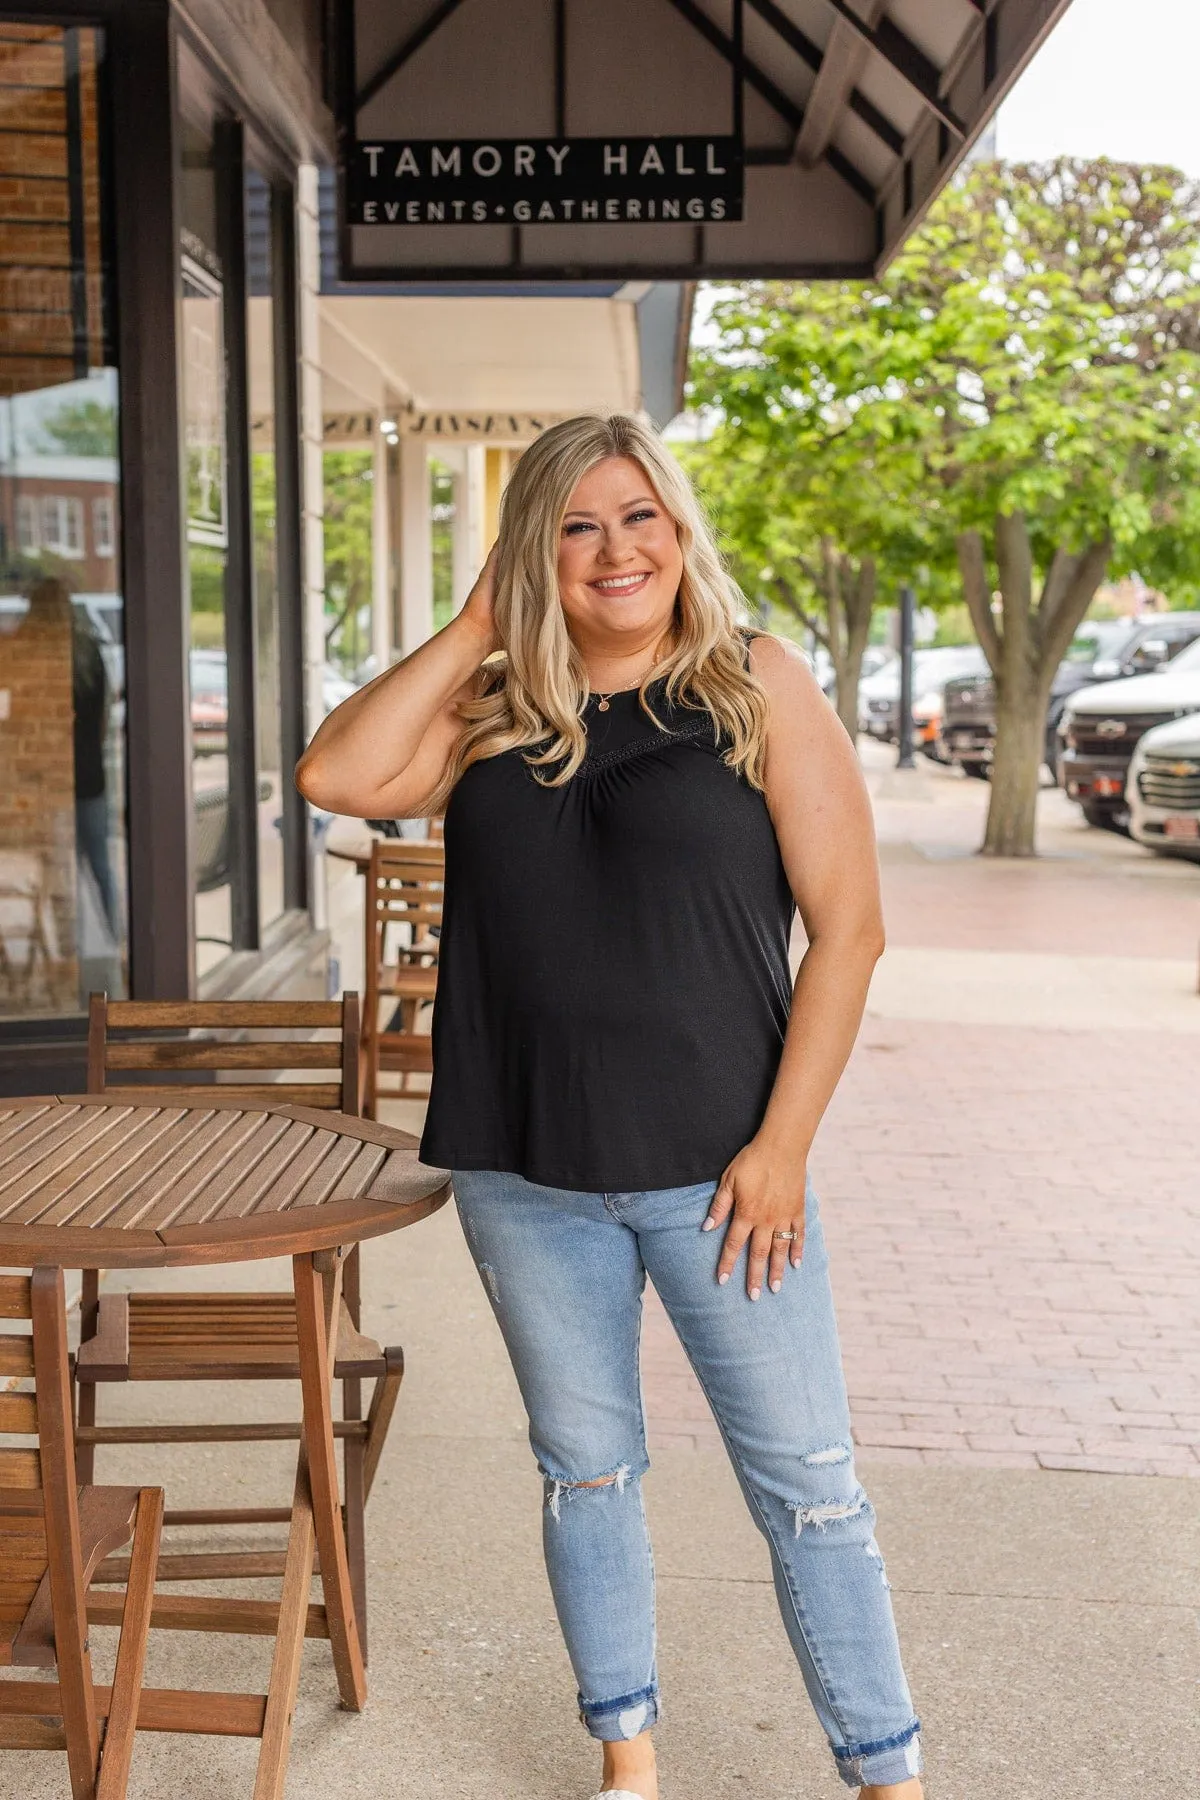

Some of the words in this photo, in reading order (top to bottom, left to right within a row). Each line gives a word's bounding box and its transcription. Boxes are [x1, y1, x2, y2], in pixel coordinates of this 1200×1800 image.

[362, 146, 571, 177] TAMORY
[604, 144, 726, 175] HALL
[362, 200, 488, 222] EVENTS
[512, 198, 726, 221] GATHERINGS
